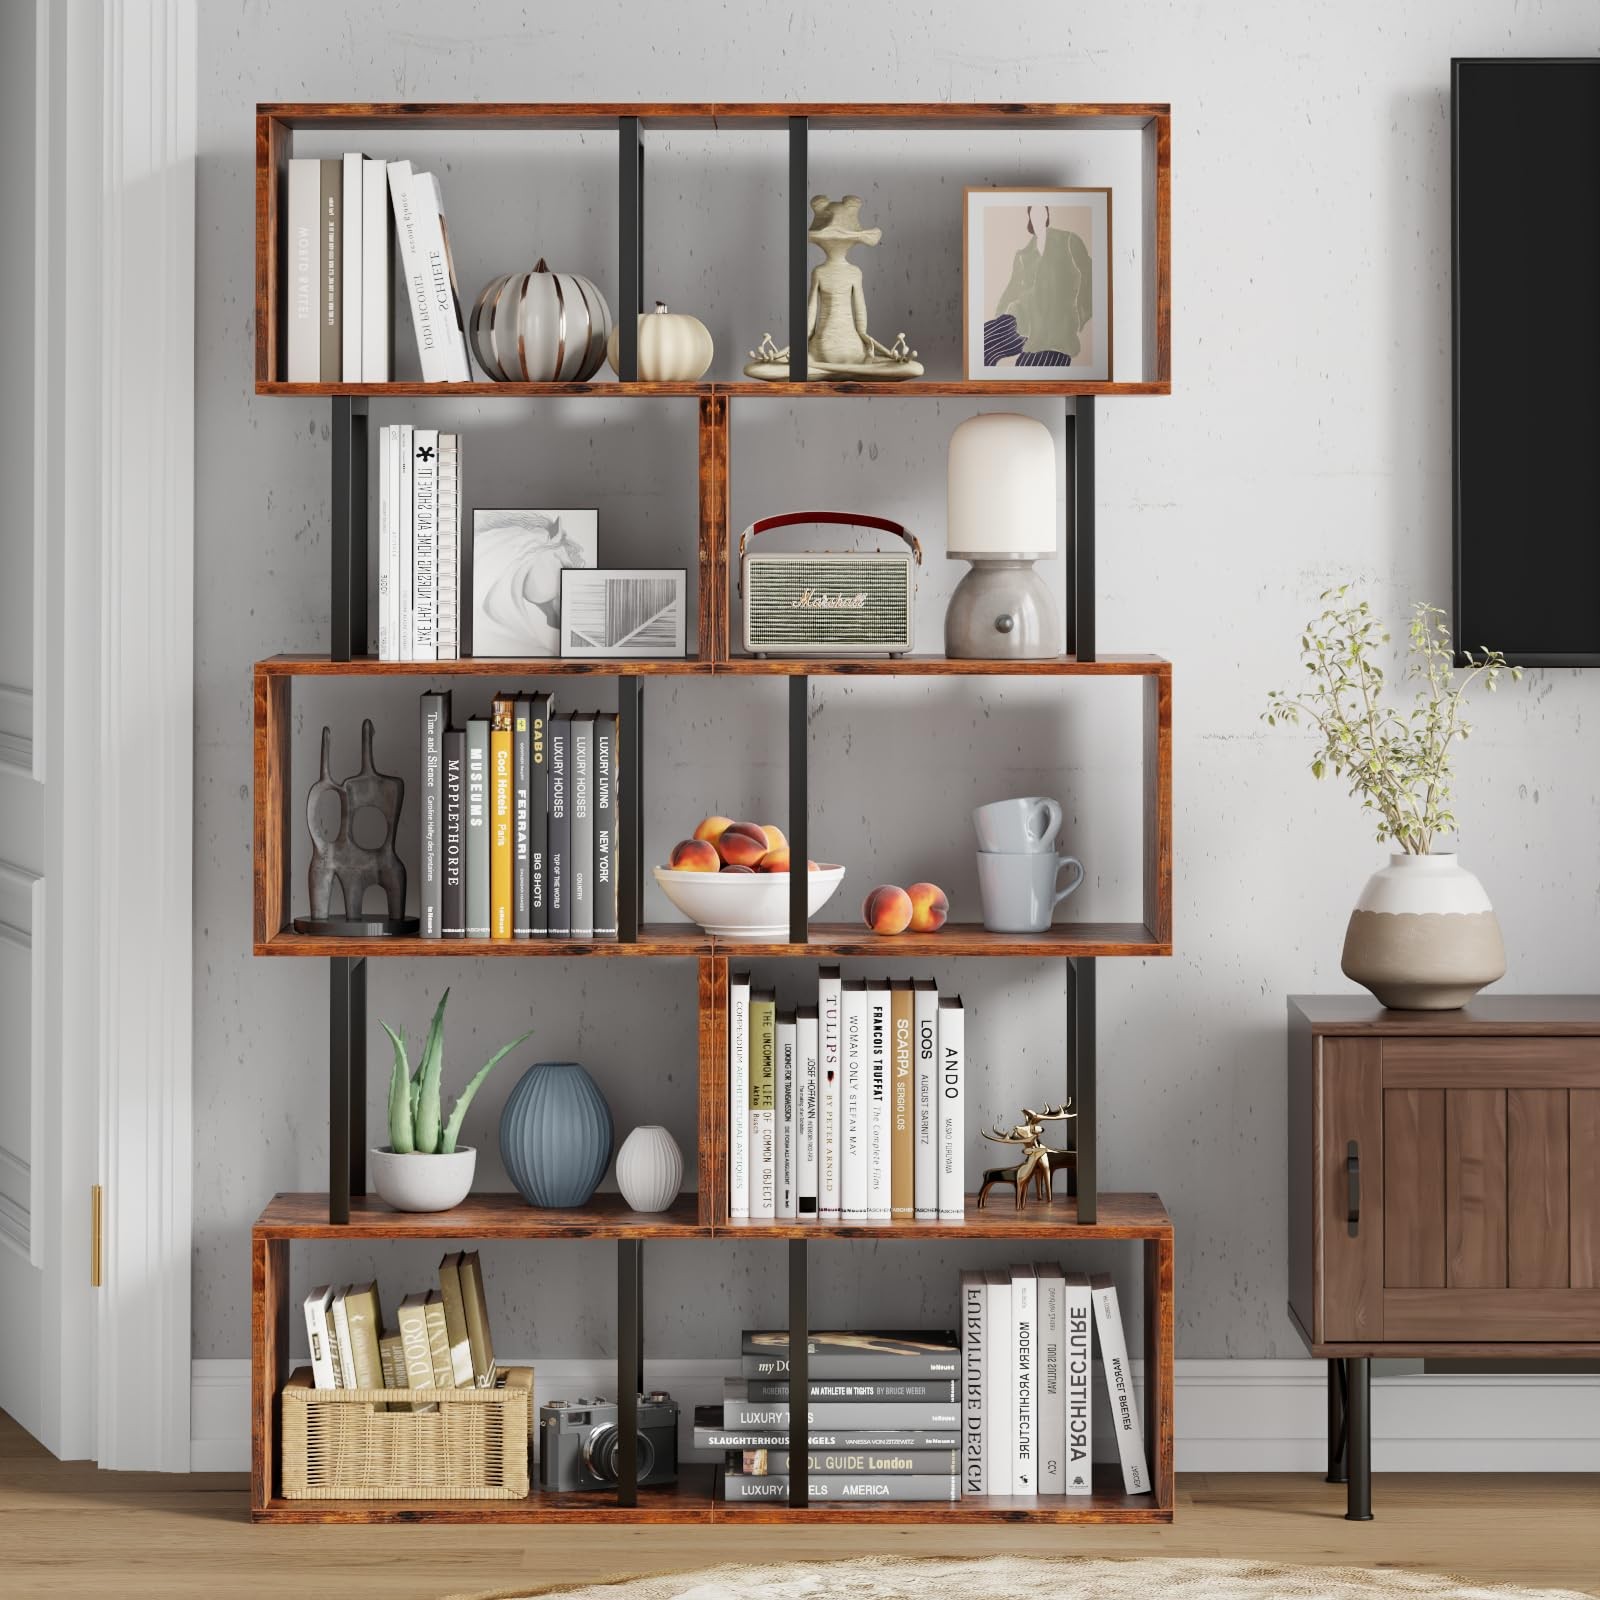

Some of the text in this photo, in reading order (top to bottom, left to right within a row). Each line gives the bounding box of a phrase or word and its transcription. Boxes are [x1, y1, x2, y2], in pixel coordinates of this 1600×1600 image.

[791, 588, 868, 608] Marshall
[427, 712, 437, 787] Time and Silence
[534, 718, 543, 764] GABO
[470, 748, 482, 827] MUSEUMS
[498, 750, 508, 847] Cool Hotels Paris
[554, 736, 563, 818] LUXURY HOUSES
[577, 736, 586, 818] LUXURY HOUSES
[600, 736, 609, 809] LUXURY LIVING
[427, 840, 435, 852] des
[448, 759, 459, 887] MAPPLETHORPE
[518, 789, 527, 860] FERRARI
[533, 851, 542, 908] BIG SHOTS
[554, 866, 560, 876] OF
[600, 830, 609, 883] NEW YORK
[826, 994, 837, 1064] TULIPS
[850, 1015, 859, 1058] WOMAN
[873, 1006, 883, 1102] FRANCOIS TRUFFAT
[921, 1020, 933, 1060] LOOS
[784, 1043, 792, 1069] LOOKING
[784, 1070, 792, 1081] FOR
[850, 1061, 859, 1091] ONLY
[897, 1019, 909, 1130] SCARPA SERGIO LOS
[945, 1047, 959, 1099] ANDO
[762, 1010, 772, 1209] THE UNCOMMON LIFE OF COMMON OBJECTS
[807, 1057, 816, 1119] JOSEF HOFFMANN
[826, 1094, 832, 1106] BY
[921, 1074, 929, 1145] AUGUST SARNITZ
[872, 1106, 882, 1190] The Complete Films
[759, 1362, 774, 1374] my
[811, 1387, 819, 1395] AN
[820, 1387, 845, 1395] ATHLETE
[853, 1387, 874, 1395] TIGHTS
[877, 1387, 884, 1395] BY
[886, 1387, 904, 1395] BRUCE
[905, 1387, 926, 1395] WEBER
[709, 1437, 790, 1445] SLAUGHTERHOUS
[741, 1412, 782, 1423] LUXURY
[826, 1457, 864, 1469] GUIDE
[869, 1457, 912, 1469] London
[742, 1486, 783, 1495] LUXURY
[843, 1486, 889, 1495] AMERICA
